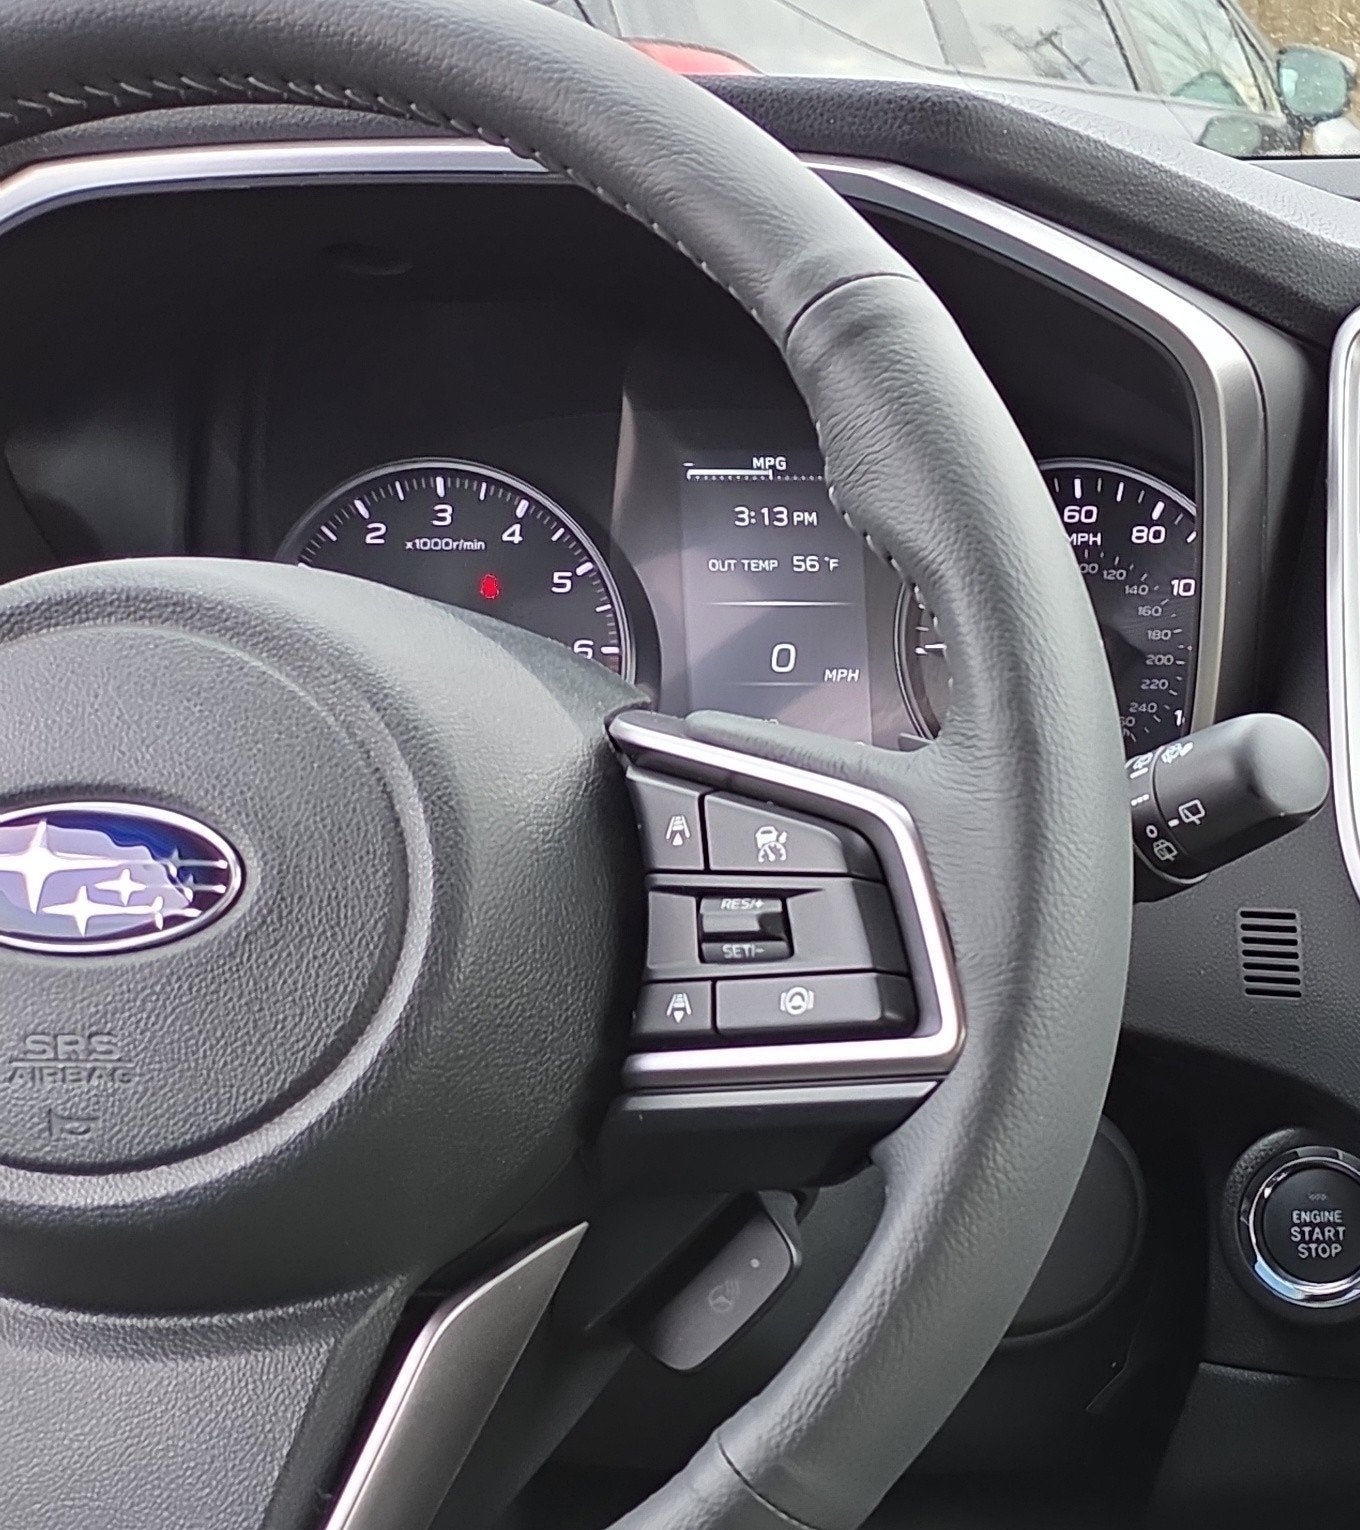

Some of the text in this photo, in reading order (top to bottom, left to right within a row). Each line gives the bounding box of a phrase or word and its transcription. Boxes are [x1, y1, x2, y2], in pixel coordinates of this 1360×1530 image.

[752, 457, 787, 471] MPG
[432, 504, 453, 525] 3
[734, 507, 817, 526] 3:13 PM
[1063, 505, 1098, 524] 60
[365, 523, 387, 544] 2
[502, 524, 523, 544] 4
[1131, 525, 1166, 544] 80
[405, 538, 485, 550] x1000r/min
[708, 559, 737, 572] OUT
[741, 559, 778, 572] TEMP
[792, 556, 820, 572] 56
[552, 571, 572, 593] 5
[1103, 569, 1127, 580] 120
[1124, 584, 1149, 595] 140
[1171, 578, 1196, 597] 10
[1138, 605, 1162, 617] 160
[1147, 629, 1172, 640] 180
[771, 643, 796, 673] 0
[1145, 654, 1174, 665] 200
[824, 669, 860, 682] MPH
[1140, 679, 1169, 690] 220
[1129, 702, 1158, 713] 240
[25, 1034, 121, 1059] SRS
[1292, 1210, 1343, 1223] ENGINE
[1290, 1226, 1346, 1242] START
[1297, 1243, 1342, 1258] STOP
